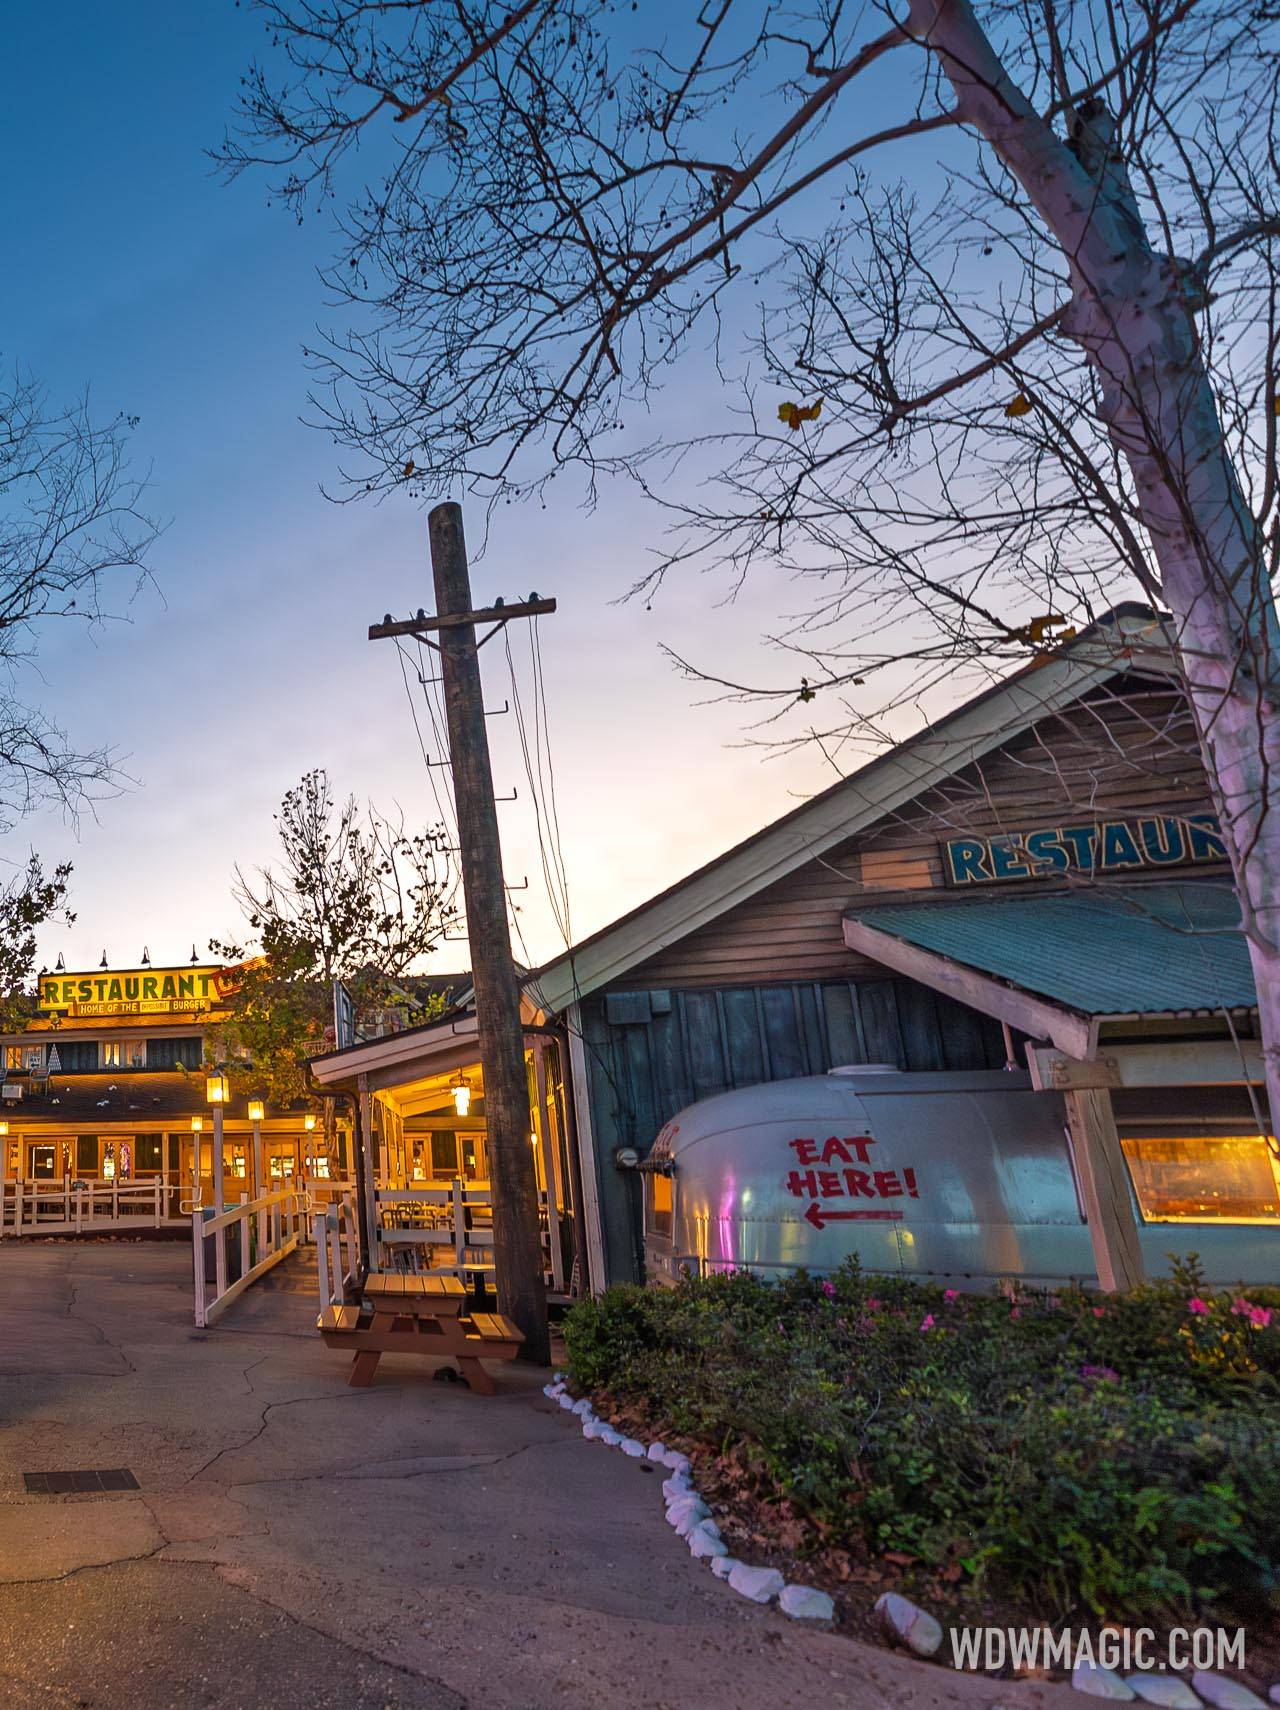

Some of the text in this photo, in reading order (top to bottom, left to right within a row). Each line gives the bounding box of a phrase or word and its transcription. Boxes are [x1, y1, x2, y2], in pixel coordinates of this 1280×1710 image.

[44, 974, 213, 1004] RESTAURANT
[80, 1003, 104, 1014] HOME
[107, 1003, 118, 1012] OF
[121, 1002, 138, 1012] THE
[173, 999, 206, 1010] BURGER
[788, 1136, 879, 1166] EAT
[786, 1168, 920, 1199] HERE!
